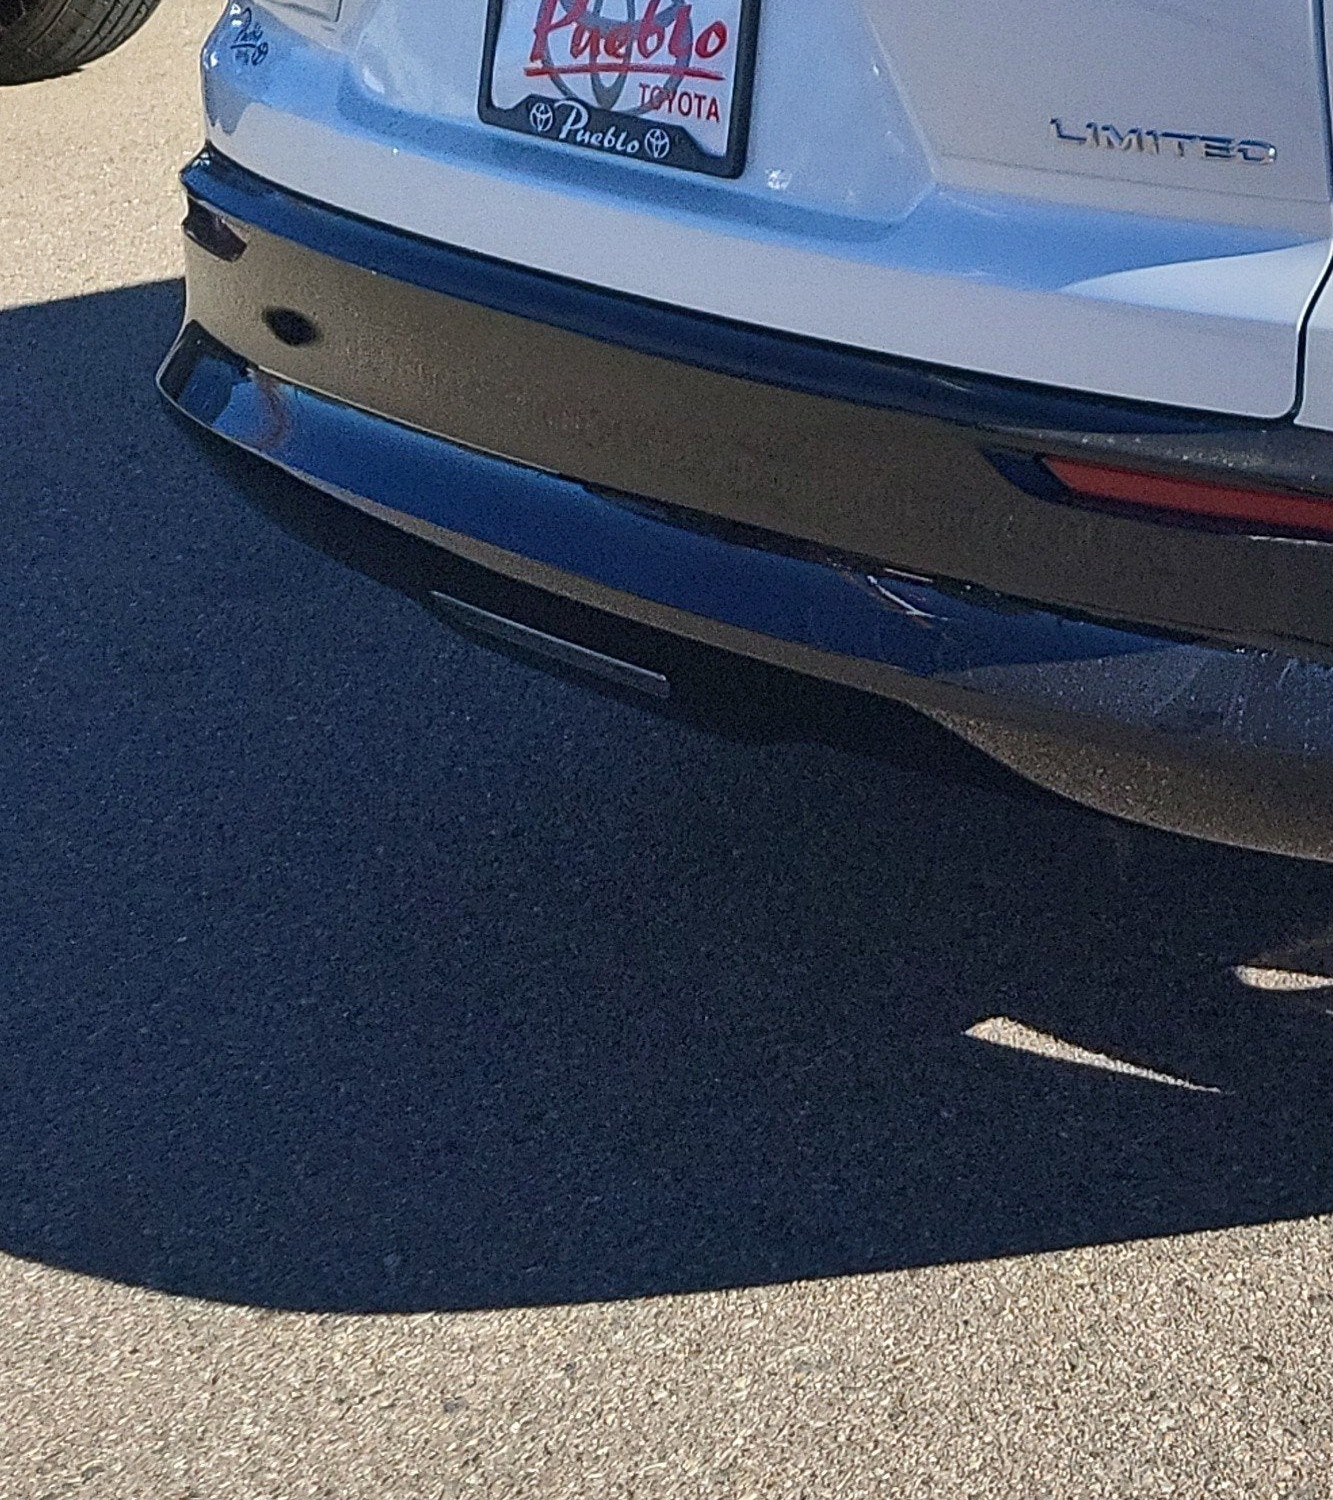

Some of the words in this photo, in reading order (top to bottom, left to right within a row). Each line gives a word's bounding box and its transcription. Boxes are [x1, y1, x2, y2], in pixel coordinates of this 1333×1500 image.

[553, 99, 640, 154] Pueblo
[638, 82, 721, 124] TOYOTA
[1050, 117, 1278, 165] LIMITED
